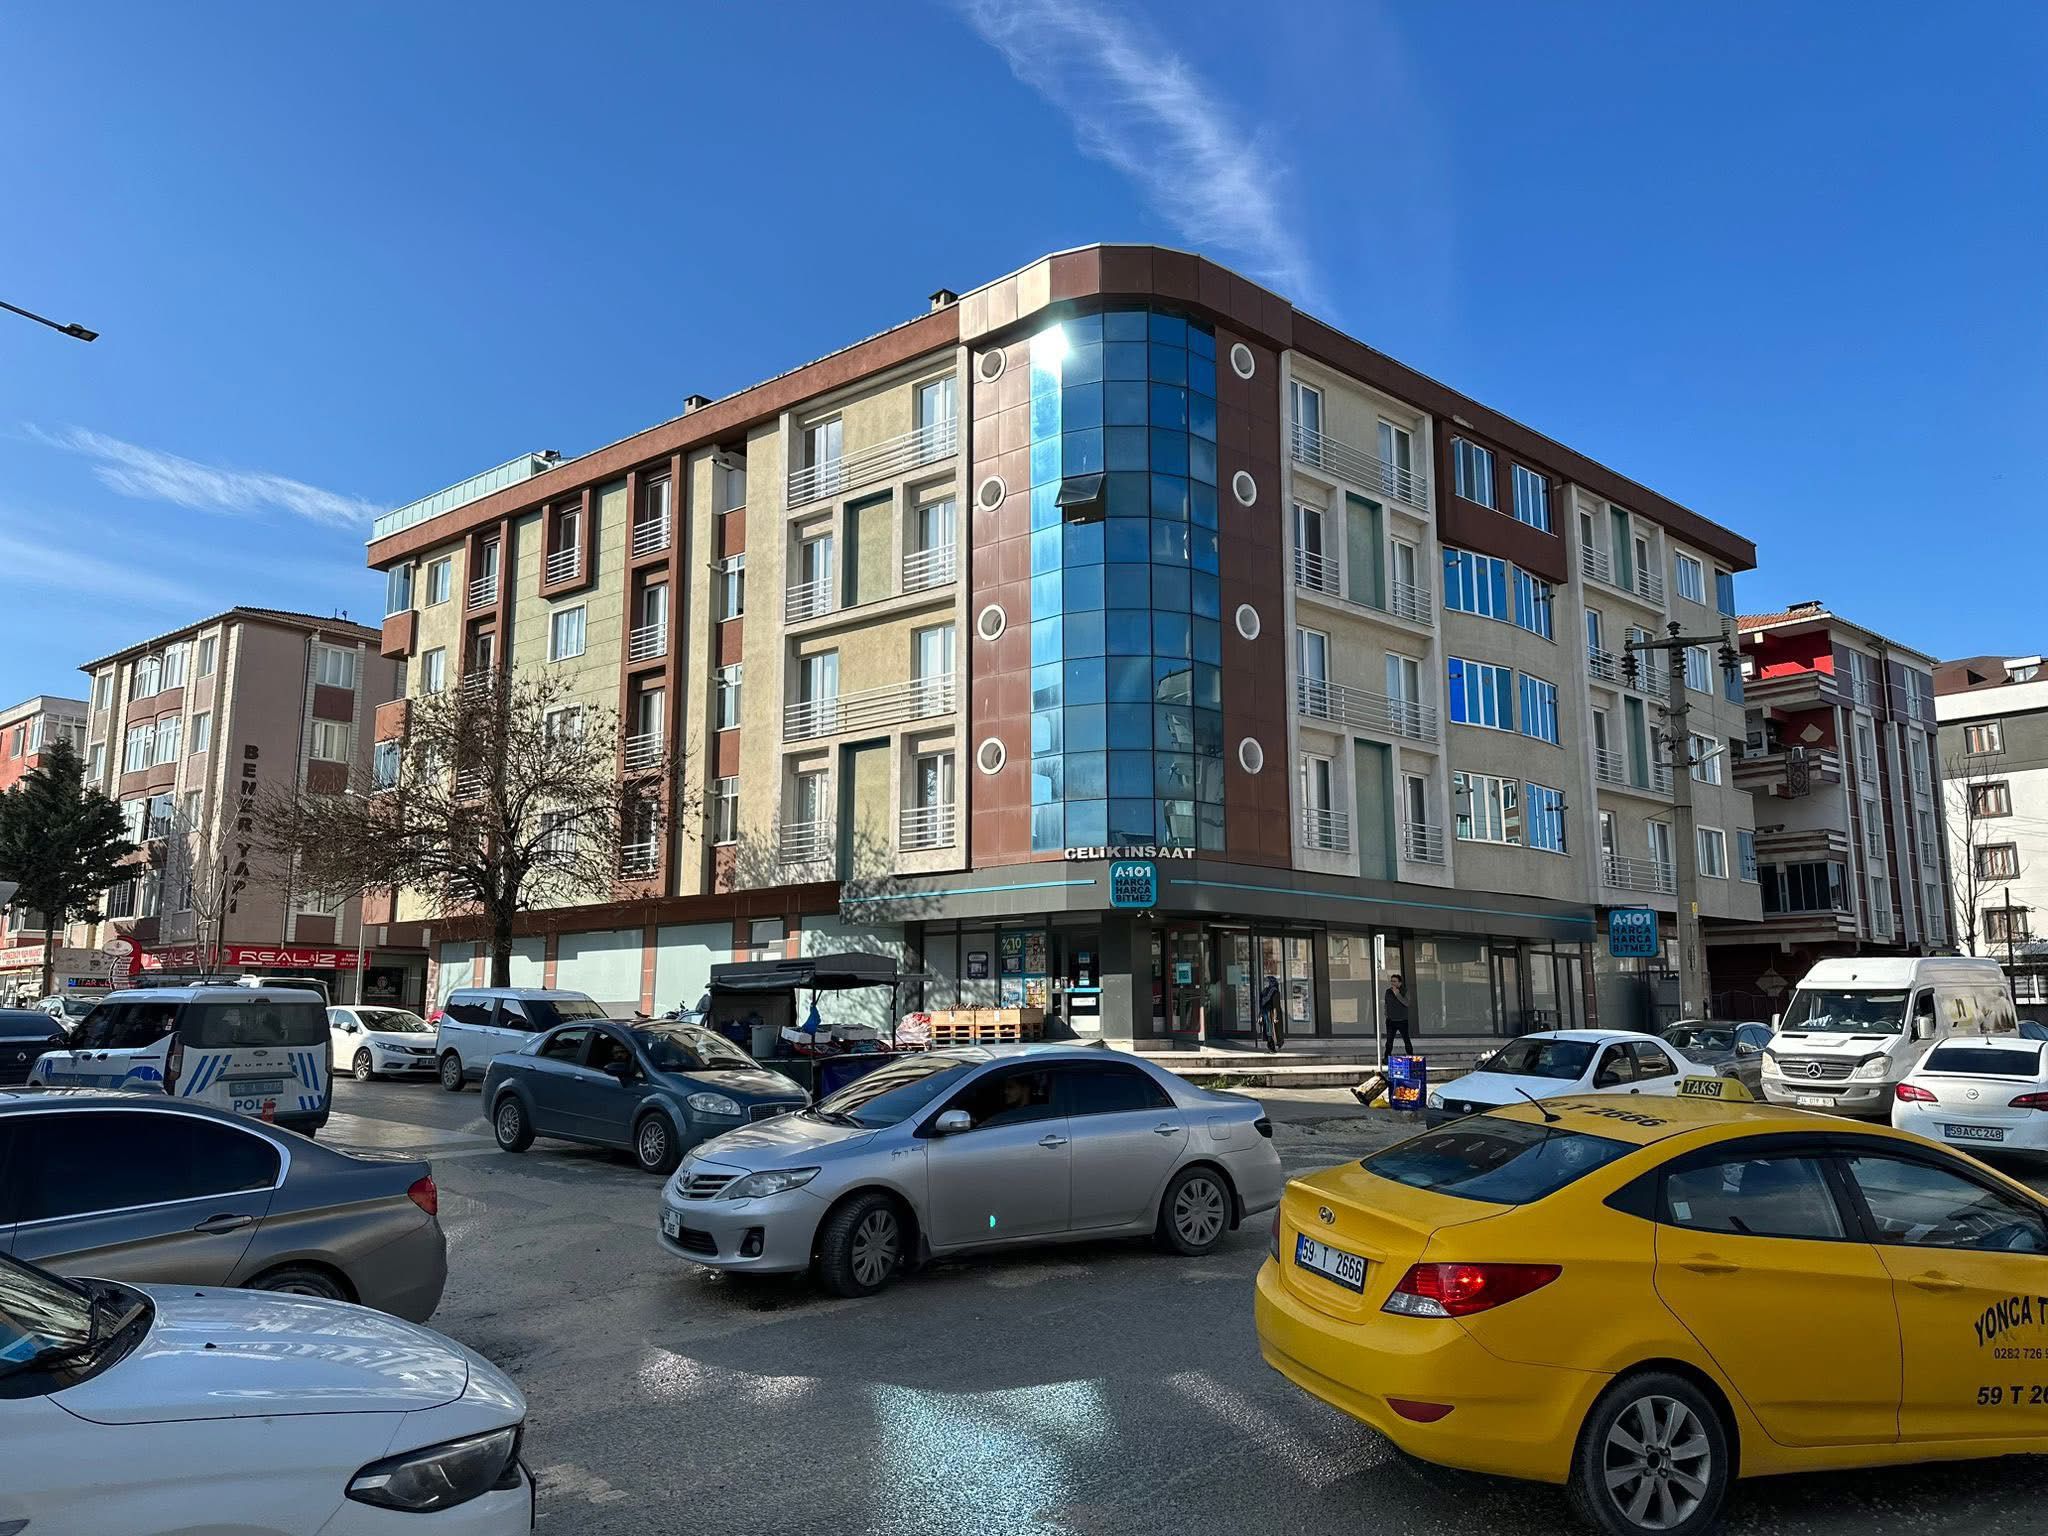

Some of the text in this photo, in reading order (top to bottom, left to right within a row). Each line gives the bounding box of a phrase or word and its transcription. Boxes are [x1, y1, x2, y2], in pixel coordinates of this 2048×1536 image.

[229, 744, 259, 913] BENER YAPI
[1613, 926, 1652, 934] HARCA
[1613, 935, 1652, 943] HARCA
[233, 1097, 277, 1112] POLS
[1584, 1107, 1668, 1127] 2666
[1302, 1238, 1363, 1283] 59 T 2666
[1974, 1295, 2033, 1348] YONCA
[1994, 1347, 2020, 1360] 0282
[2023, 1347, 2042, 1360] 726
[1977, 1386, 2003, 1406] 59
[2010, 1386, 2024, 1405] T
